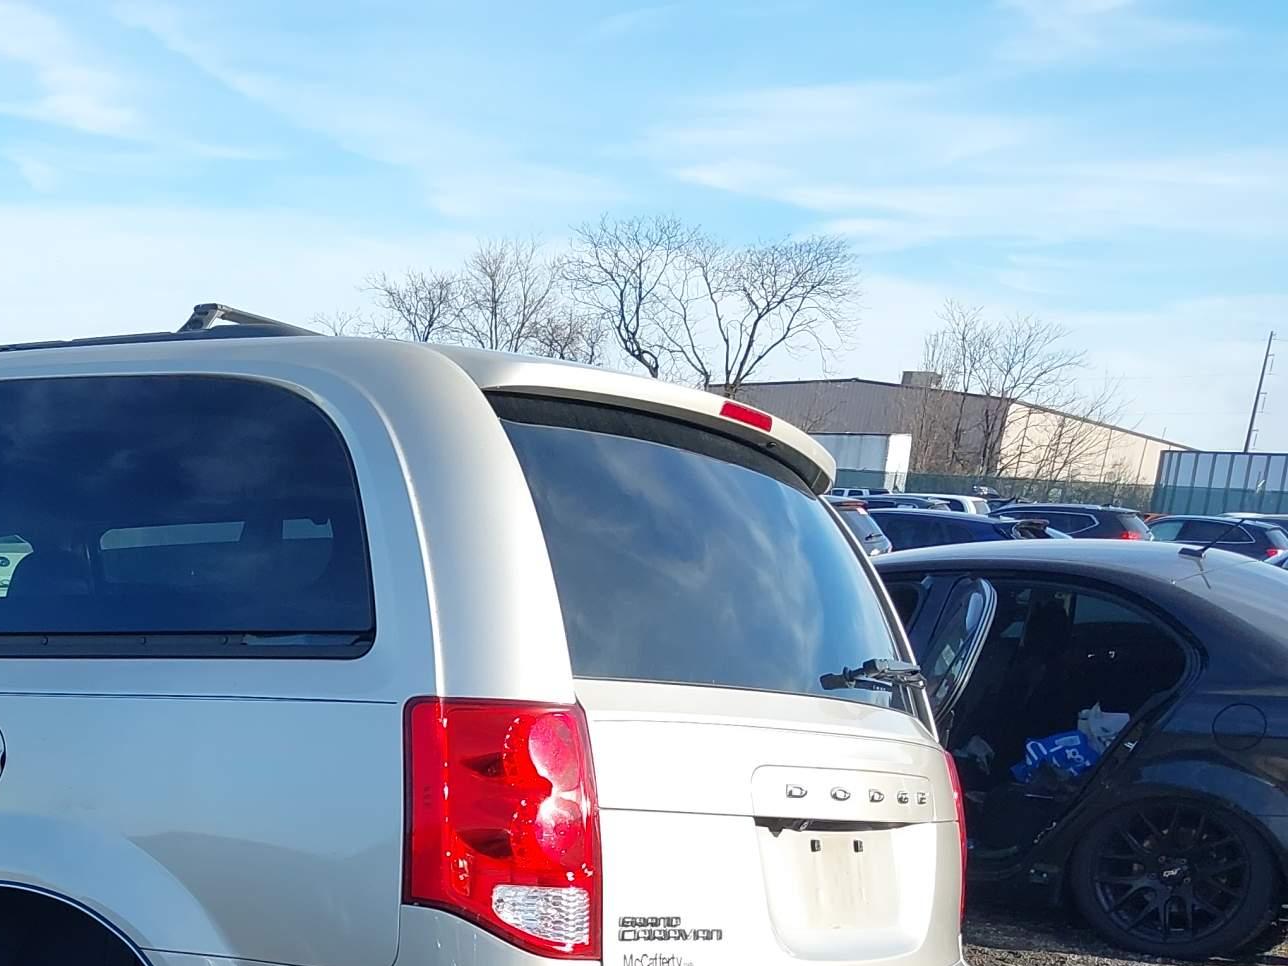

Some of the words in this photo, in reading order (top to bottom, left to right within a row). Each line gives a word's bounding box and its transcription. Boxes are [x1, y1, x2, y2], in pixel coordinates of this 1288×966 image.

[785, 784, 929, 805] DODGE
[618, 916, 682, 928] GRAND
[618, 928, 723, 941] CARAVAN
